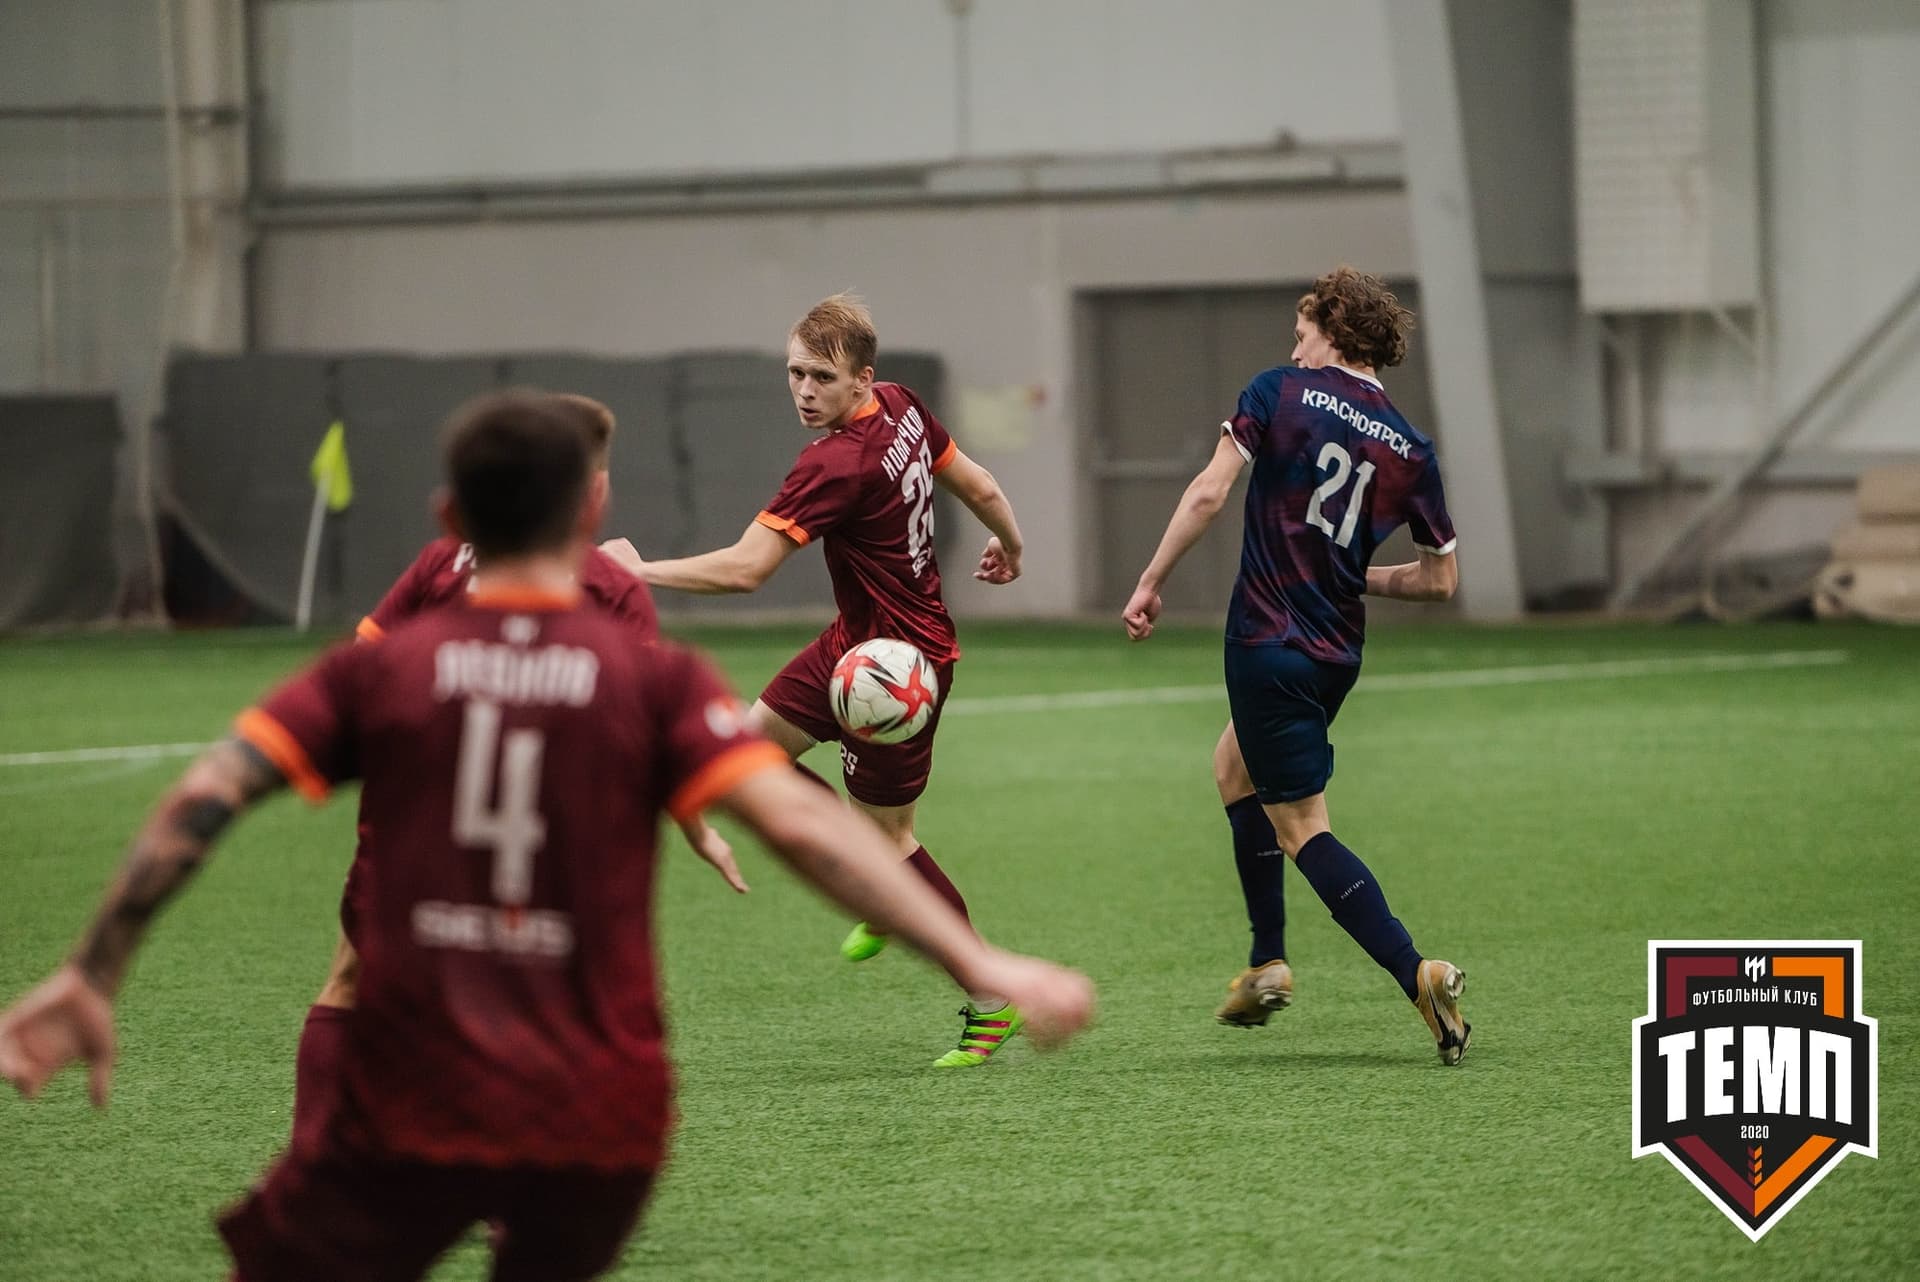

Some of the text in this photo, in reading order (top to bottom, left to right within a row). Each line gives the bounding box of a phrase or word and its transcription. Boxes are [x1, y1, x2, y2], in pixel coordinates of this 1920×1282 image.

[1302, 388, 1412, 460] КРАСНОЯРСК
[1305, 442, 1376, 549] 21
[451, 700, 547, 904] 4
